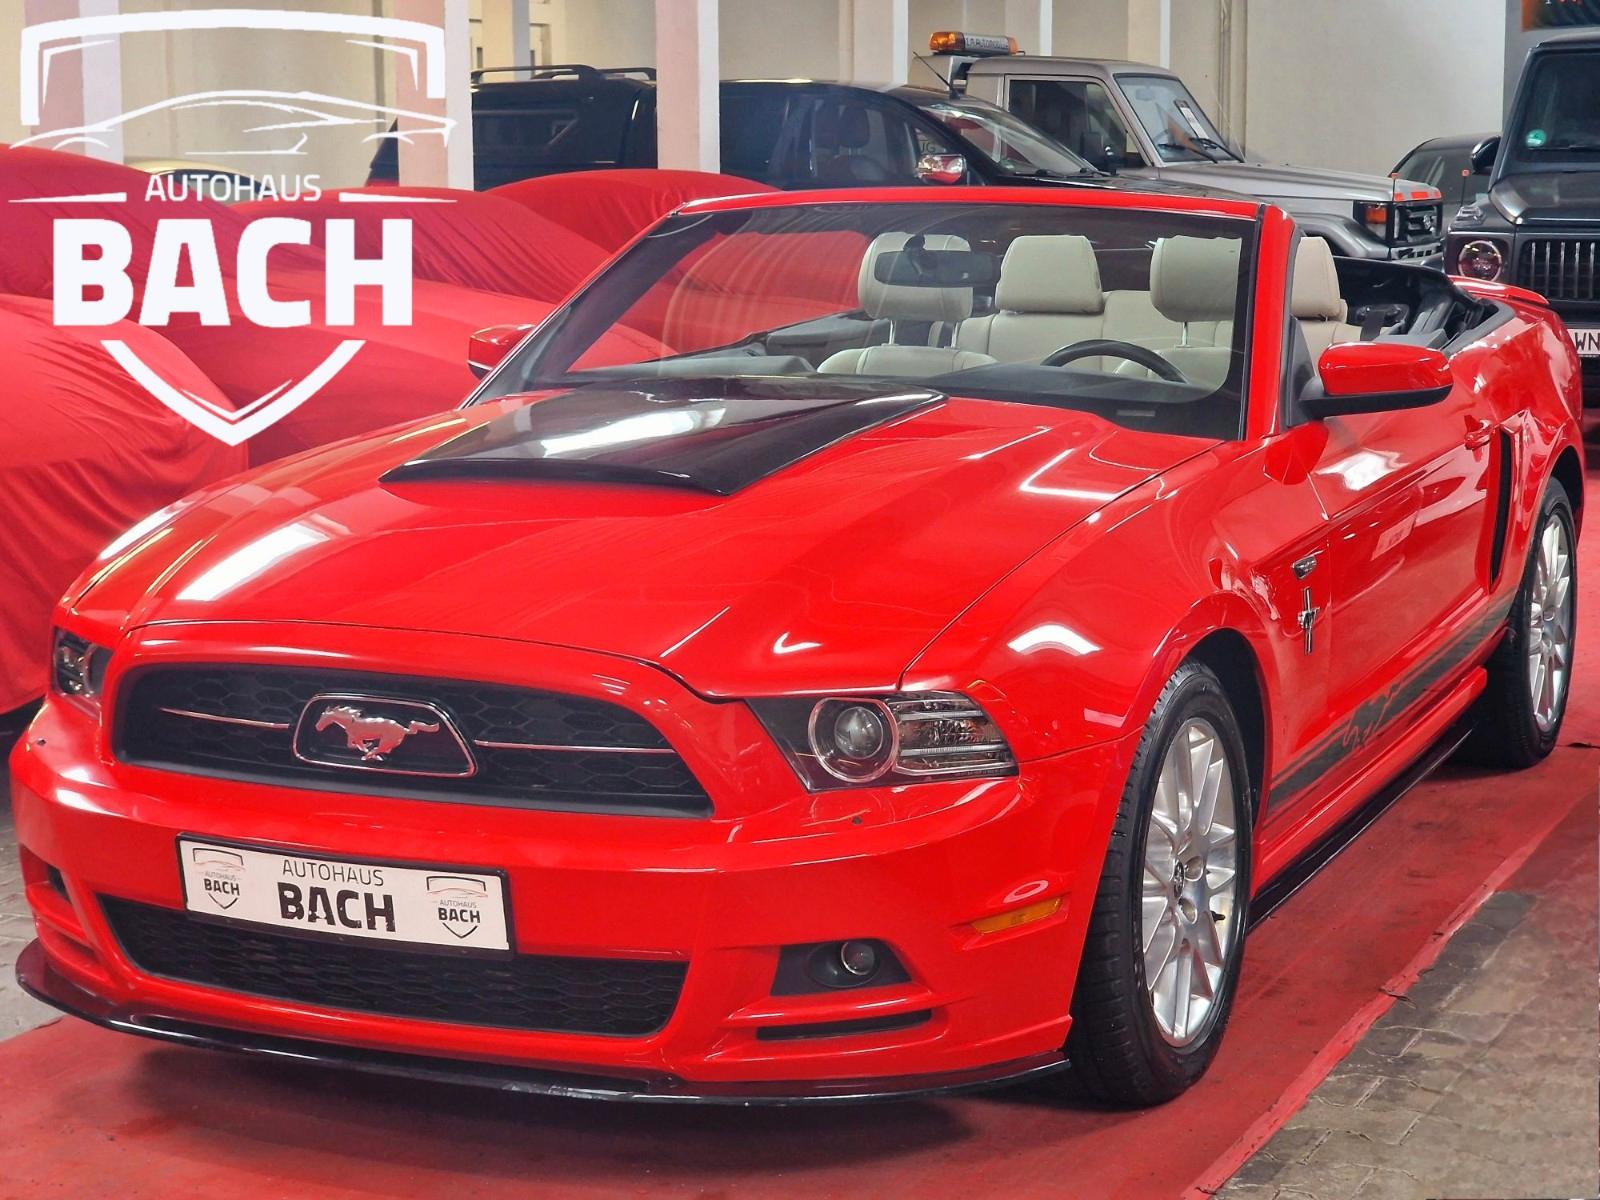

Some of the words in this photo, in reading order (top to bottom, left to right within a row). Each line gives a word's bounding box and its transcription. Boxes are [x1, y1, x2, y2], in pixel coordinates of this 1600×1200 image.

[205, 871, 237, 882] AUTOHAUS
[283, 859, 384, 886] AUTOHAUS
[203, 878, 240, 896] BACH
[277, 881, 396, 933] BACH
[439, 899, 477, 909] AUTOHAUS
[438, 907, 481, 923] BACH
